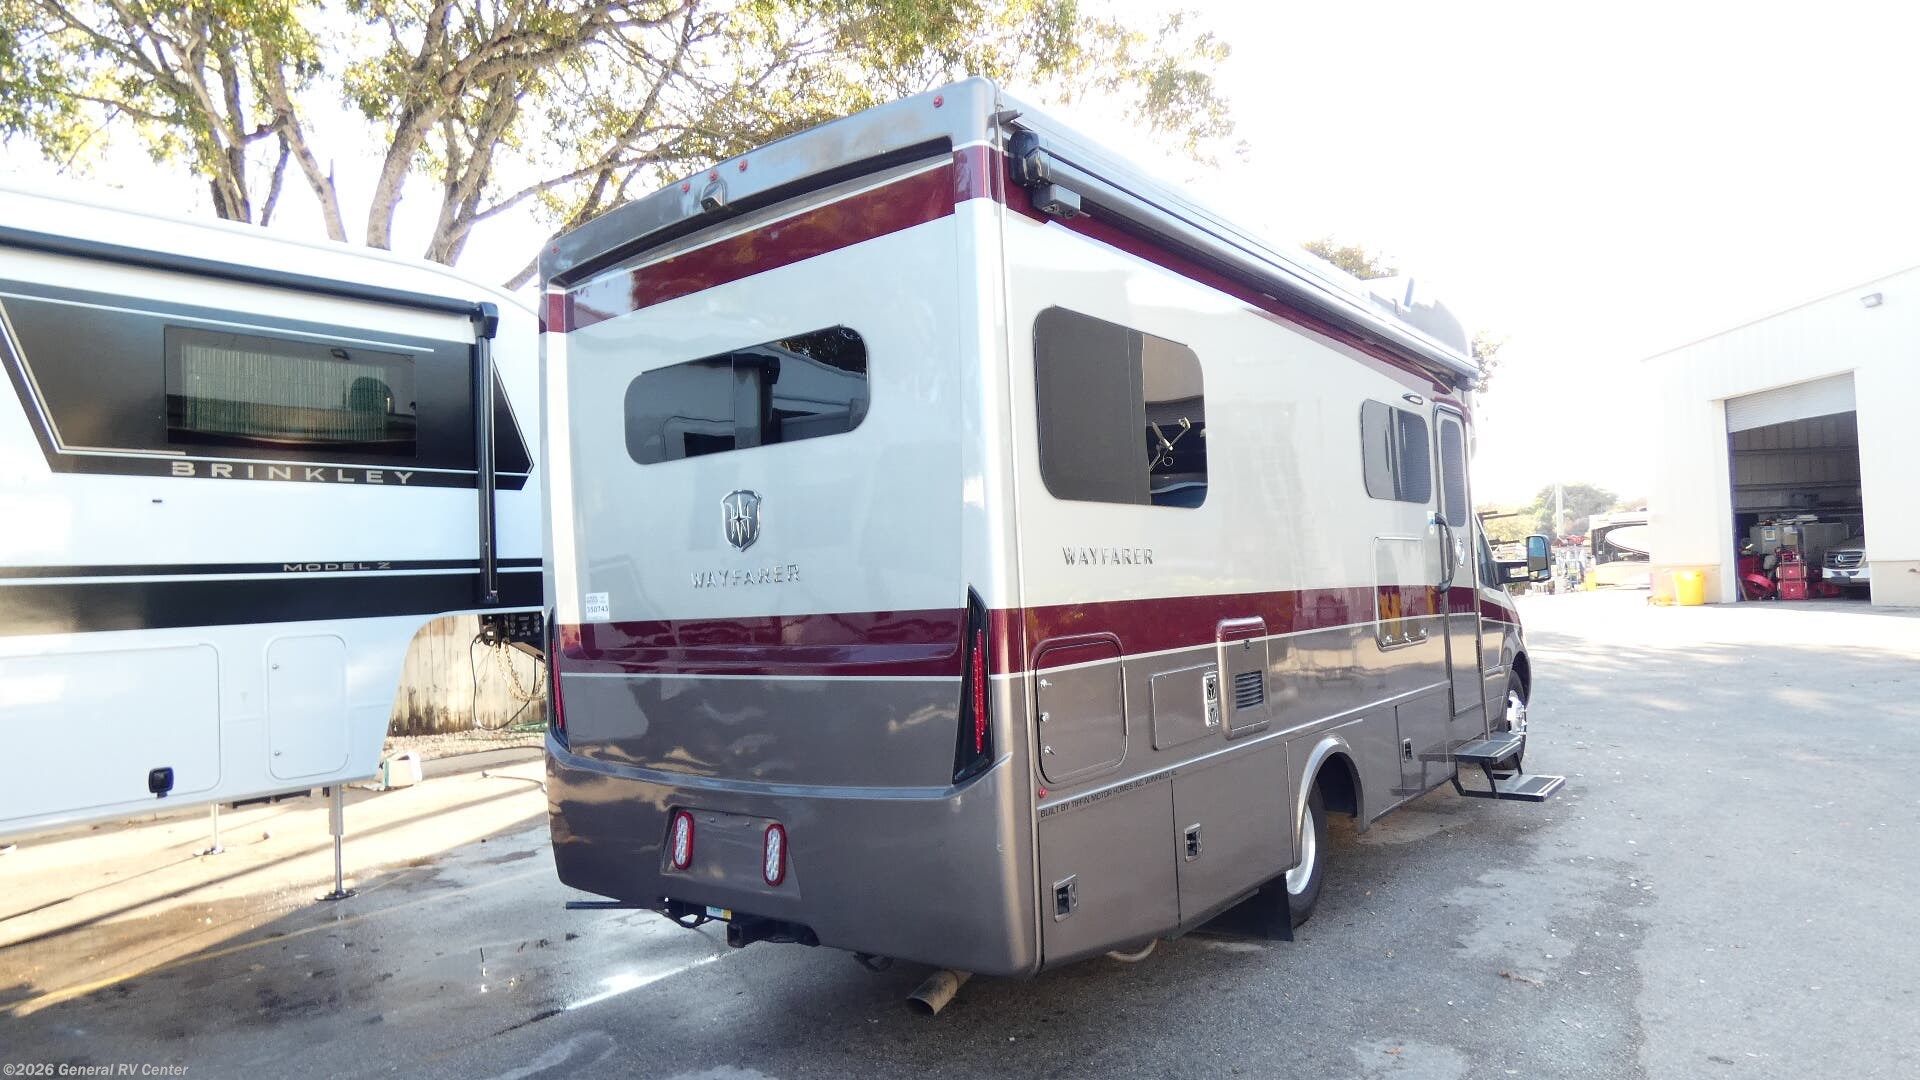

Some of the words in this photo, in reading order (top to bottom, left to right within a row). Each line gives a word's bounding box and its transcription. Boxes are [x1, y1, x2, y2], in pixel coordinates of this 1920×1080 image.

[171, 461, 414, 484] BRINKLEY
[283, 562, 370, 572] MODEL
[378, 561, 391, 569] Z
[1062, 546, 1153, 566] WAYFARER
[691, 564, 800, 589] WAYFARER
[1040, 805, 1059, 817] BUILT
[1060, 801, 1070, 811] BY
[1091, 789, 1112, 801] MOTOR
